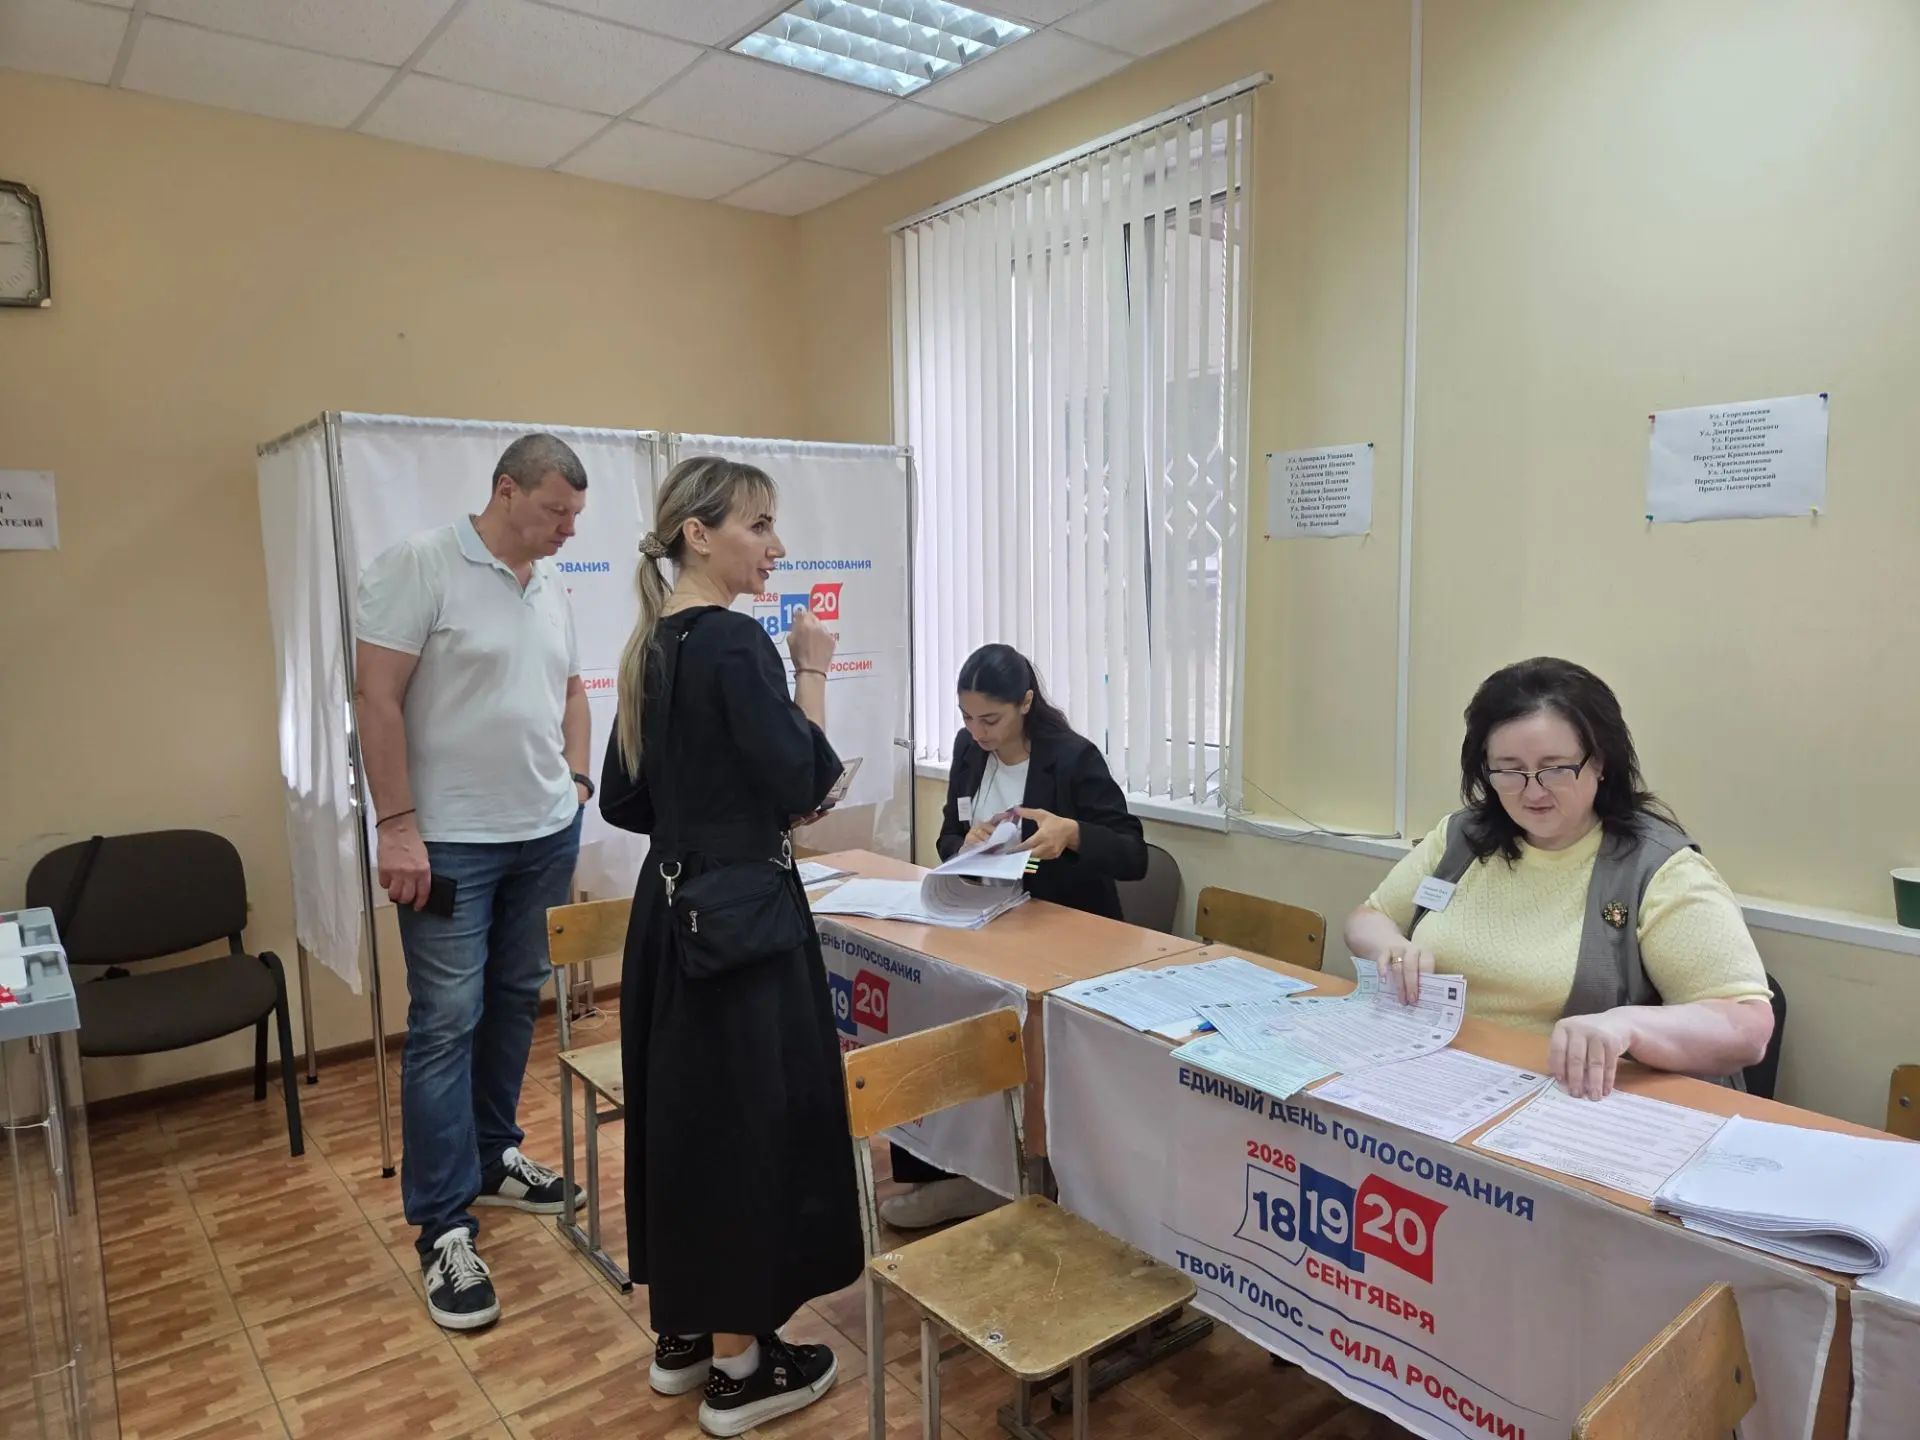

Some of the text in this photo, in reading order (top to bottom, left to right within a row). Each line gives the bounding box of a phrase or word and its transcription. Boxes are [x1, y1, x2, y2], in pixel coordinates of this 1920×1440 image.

[1693, 453, 1726, 461] Переулок
[0, 517, 43, 527] ТЕЛЕЙ
[556, 562, 610, 572] ОВАНИЯ
[774, 560, 872, 570] ЕНЬ ГОЛОСОВАНИЯ
[754, 593, 778, 602] 2026
[812, 592, 837, 613] 20
[830, 660, 873, 672] РОССИИ!
[583, 679, 614, 690] СИИ!
[821, 933, 840, 949] ЕНЬ
[830, 982, 886, 1020] 19 20
[1178, 1067, 1265, 1114] ЕДИНЫЙ
[1269, 1100, 1328, 1135] ДЕНЬ
[1332, 1120, 1535, 1222] ГОЛОСОВАНИЯ
[1246, 1140, 1297, 1173] 2026
[1252, 1189, 1427, 1256] 18 19 20
[1305, 1257, 1436, 1335] СЕНТЯБРЯ
[1175, 1249, 1234, 1289] ТВОЙ
[1238, 1275, 1304, 1327] ГОЛОС
[1329, 1328, 1398, 1380] СИЛА
